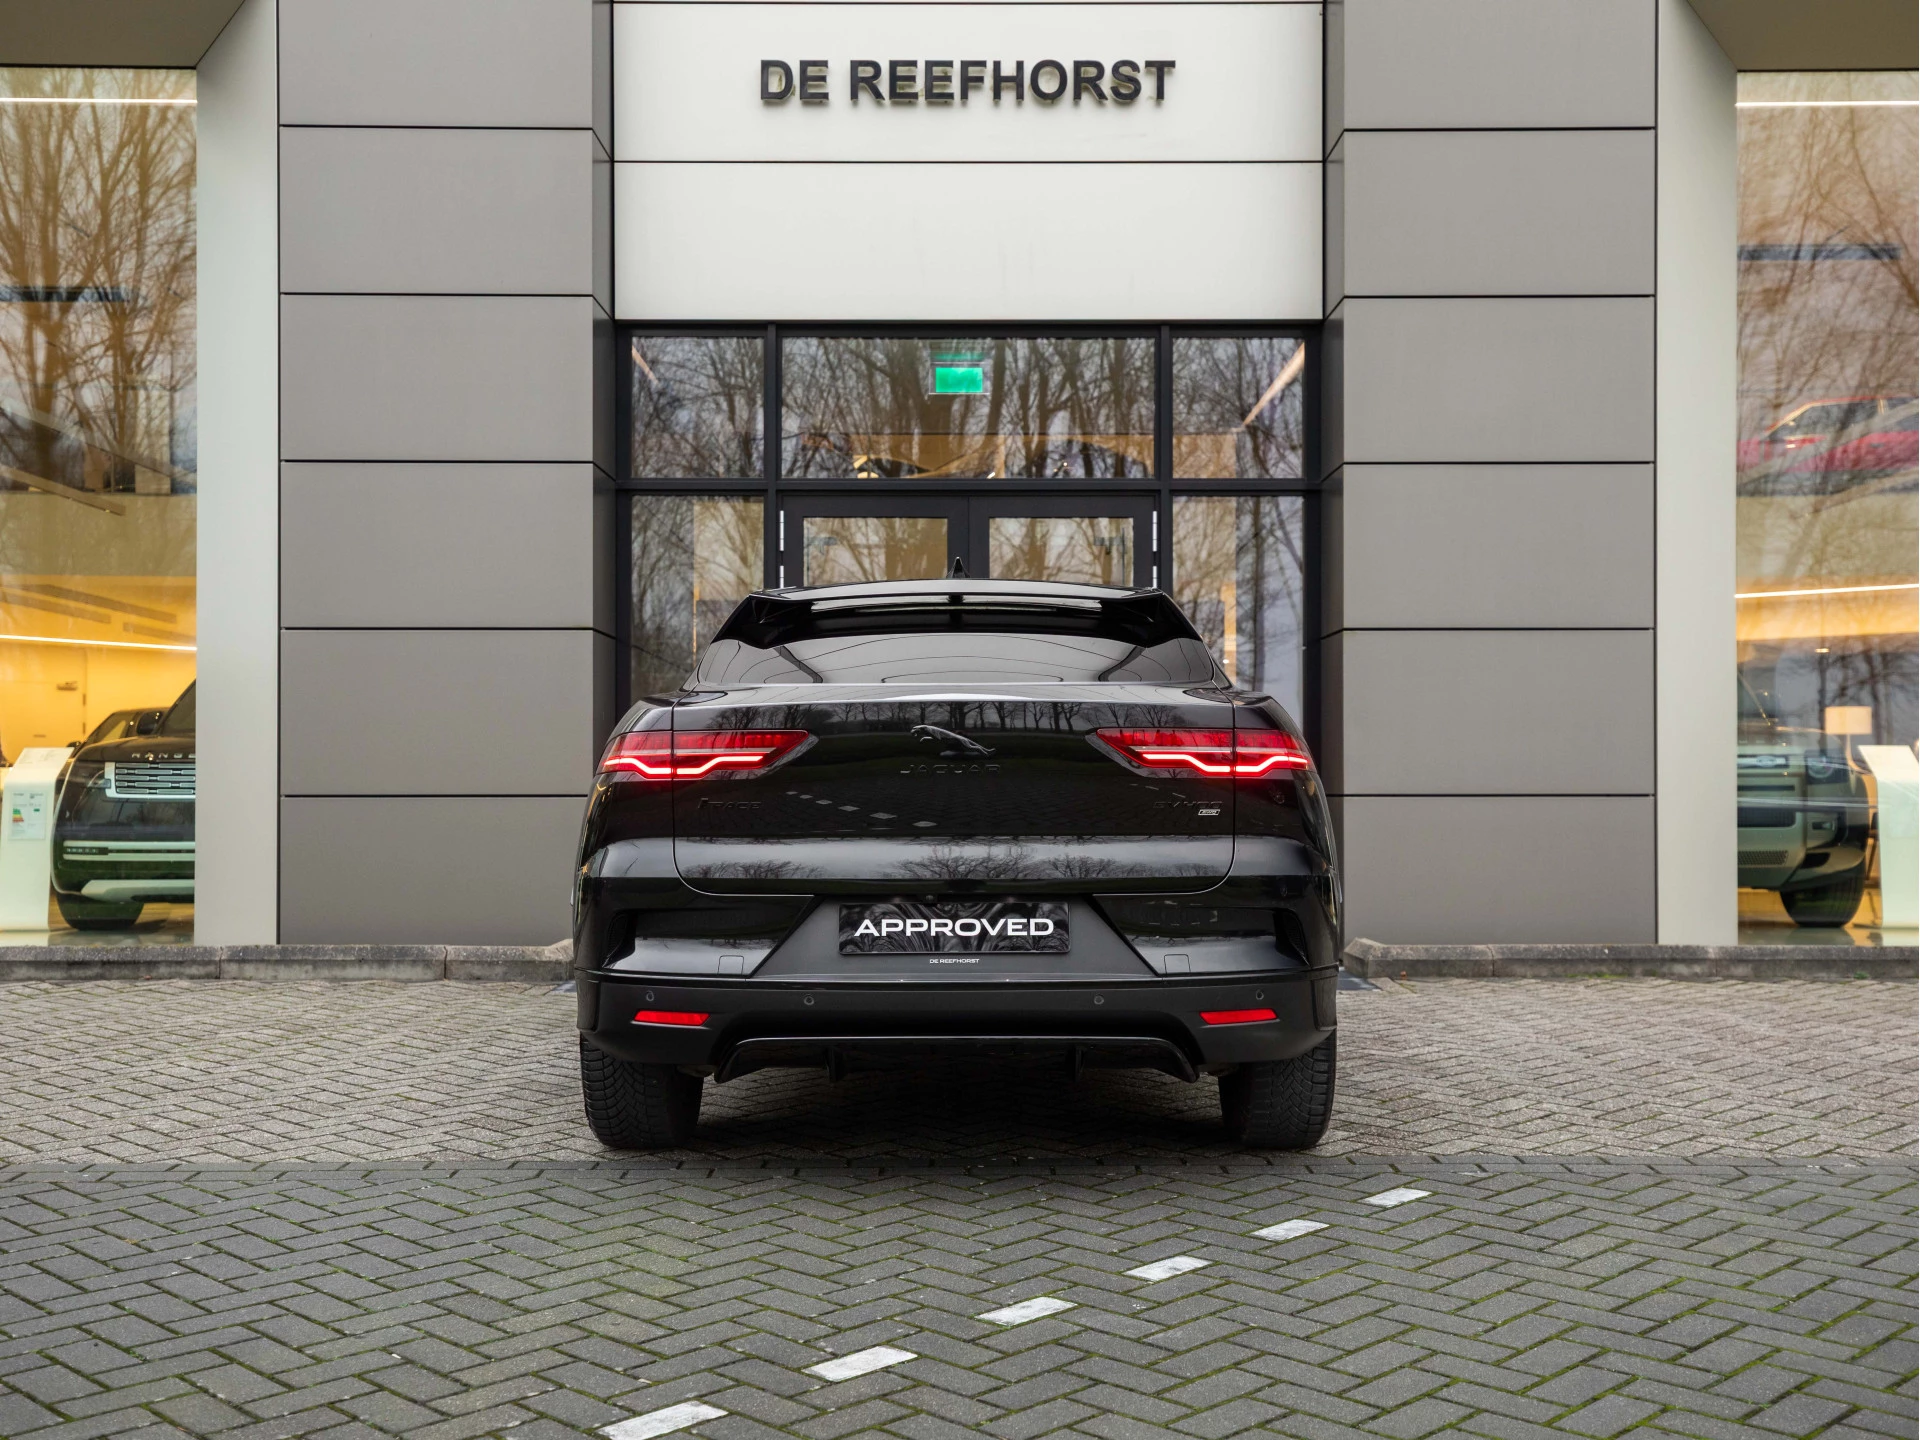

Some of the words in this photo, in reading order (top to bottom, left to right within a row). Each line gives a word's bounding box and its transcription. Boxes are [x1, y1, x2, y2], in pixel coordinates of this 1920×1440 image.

[760, 59, 829, 102] DE
[850, 59, 1176, 102] REEFHORST
[899, 764, 1001, 774] JAGUAR
[854, 918, 1054, 937] APPROVED
